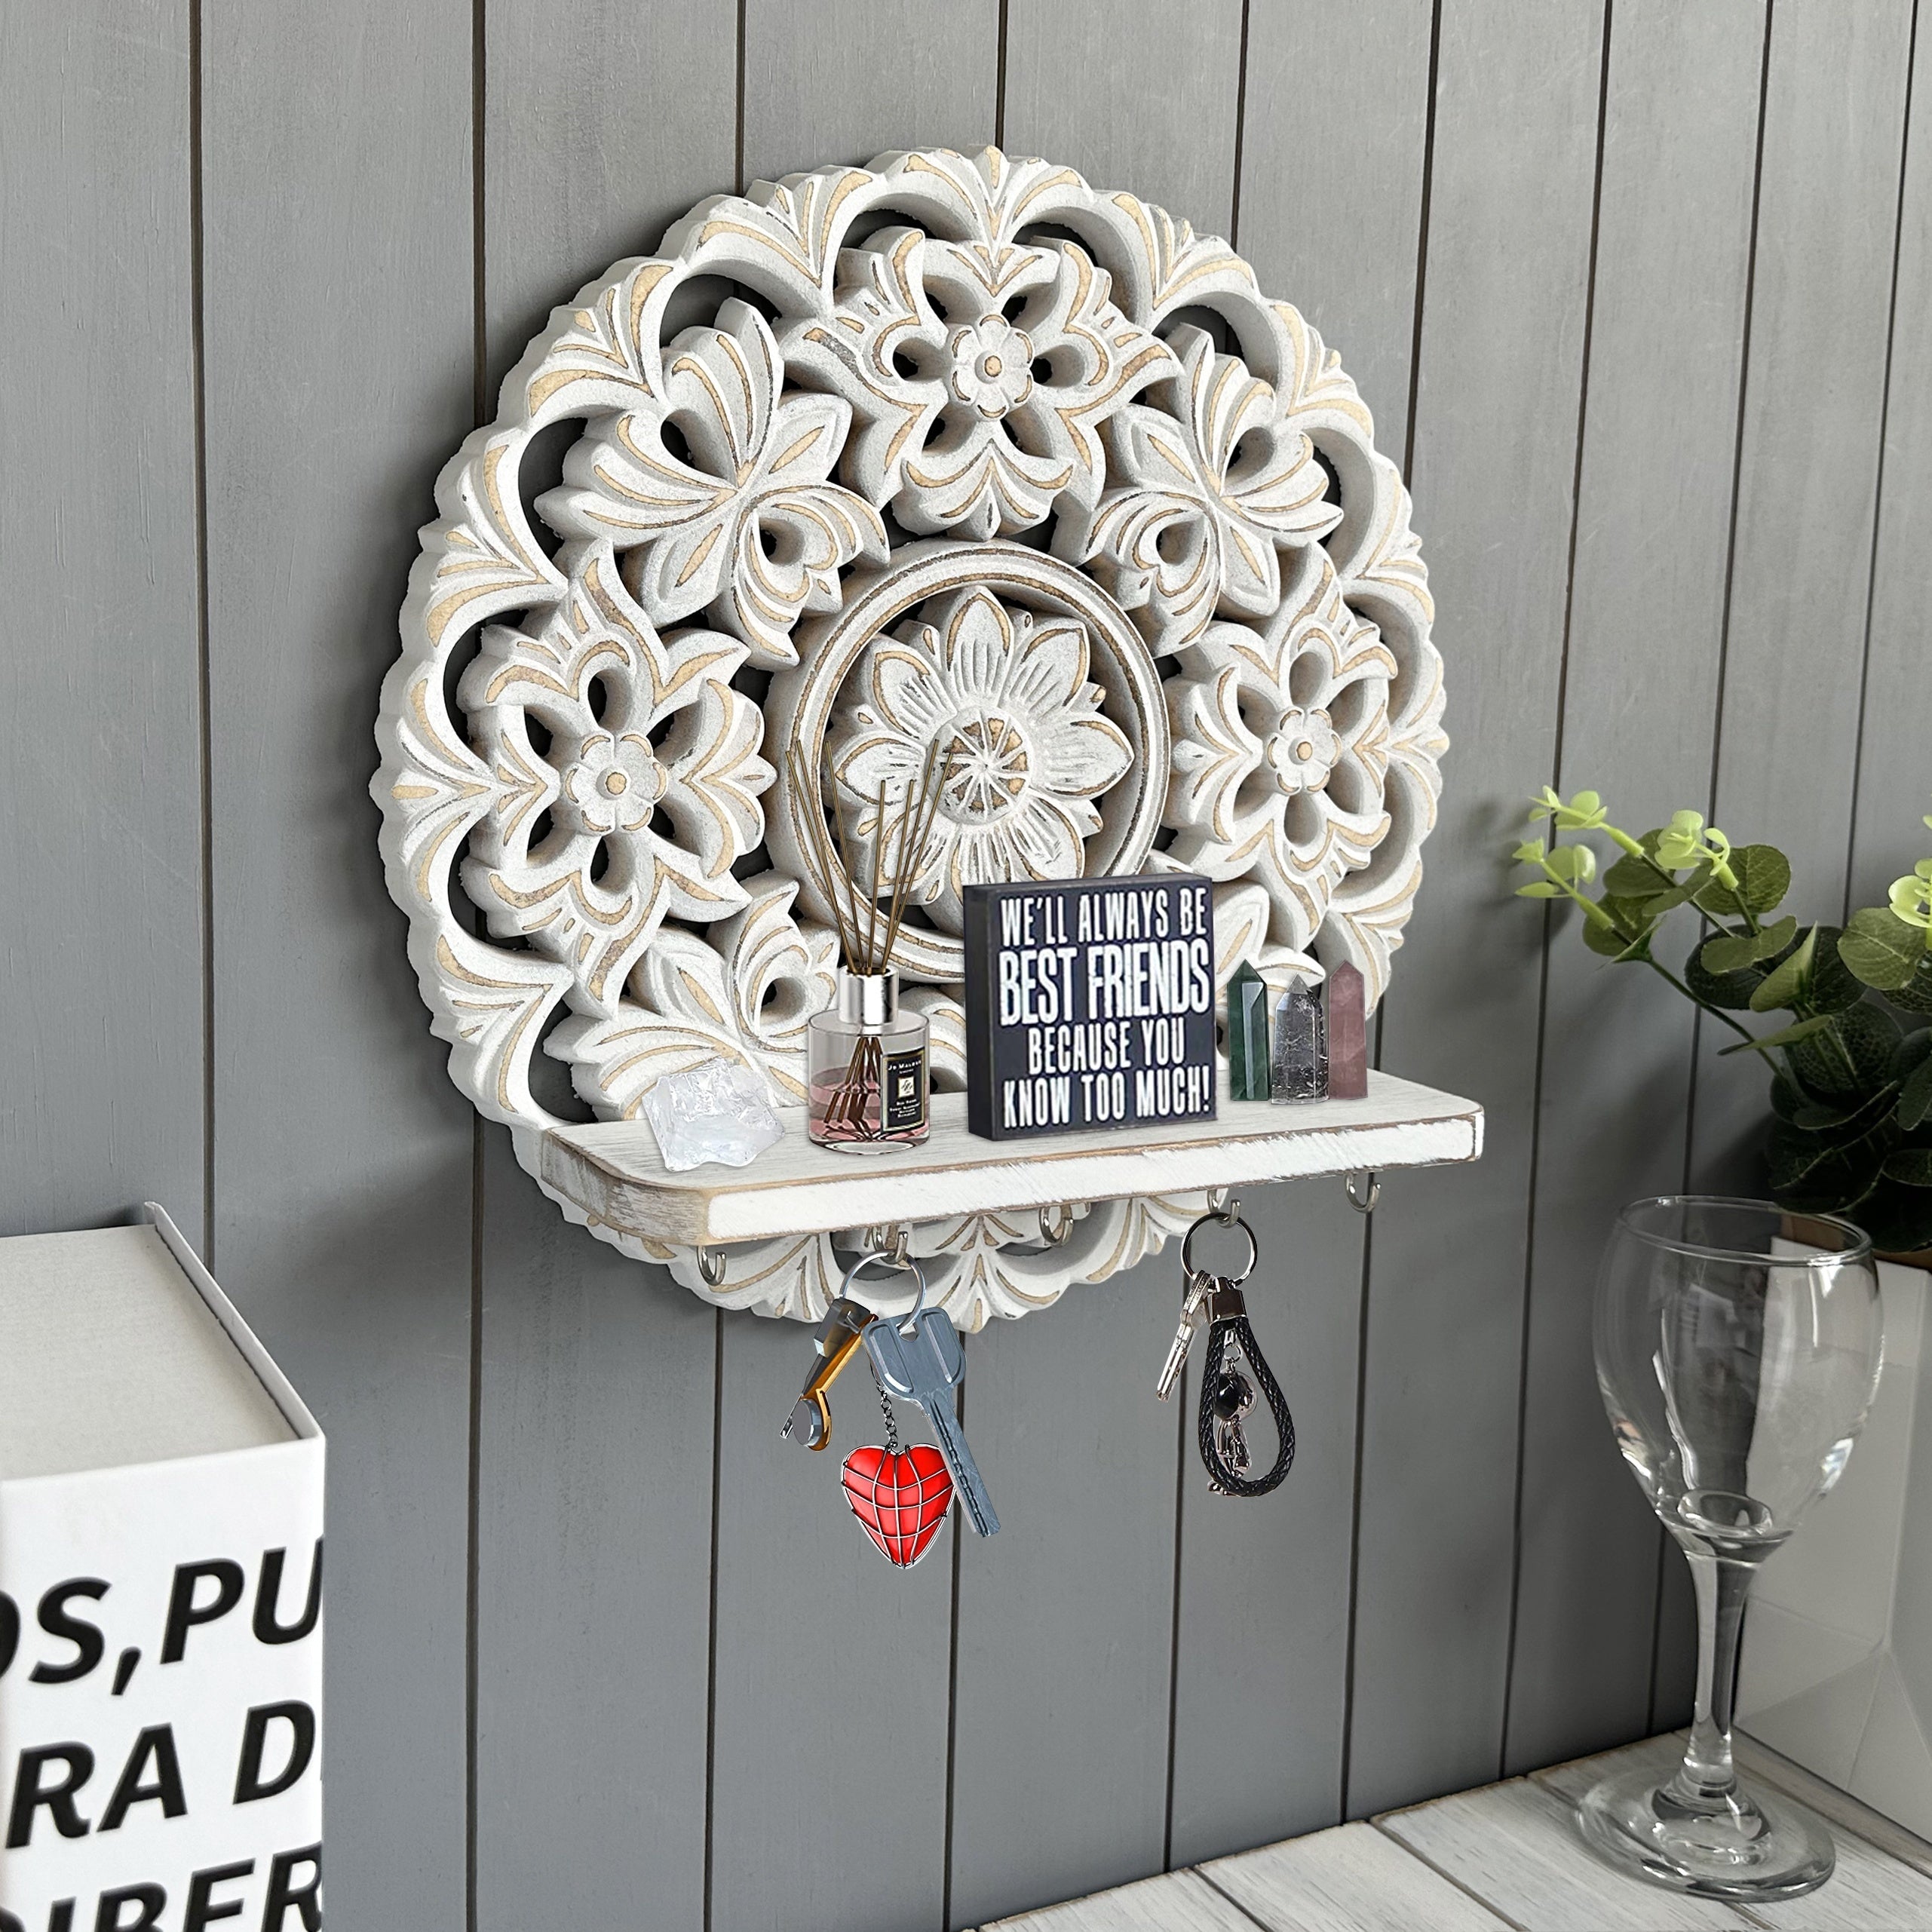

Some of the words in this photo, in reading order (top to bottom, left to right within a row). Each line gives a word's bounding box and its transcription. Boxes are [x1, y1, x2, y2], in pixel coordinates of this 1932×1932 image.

[1001, 897, 1067, 946] WE'LL
[1078, 890, 1168, 942] ALWAYS
[1180, 888, 1206, 935] BE
[1000, 947, 1077, 1026] BEST
[1088, 938, 1209, 1019] FRIENDS
[1029, 1021, 1130, 1075] BECAUSE
[1142, 1017, 1184, 1066] YOU
[1004, 1077, 1069, 1127] KNOW
[1081, 1072, 1124, 1121] TOO
[1136, 1066, 1209, 1117] MUCH!
[233, 1701, 315, 1805] D
